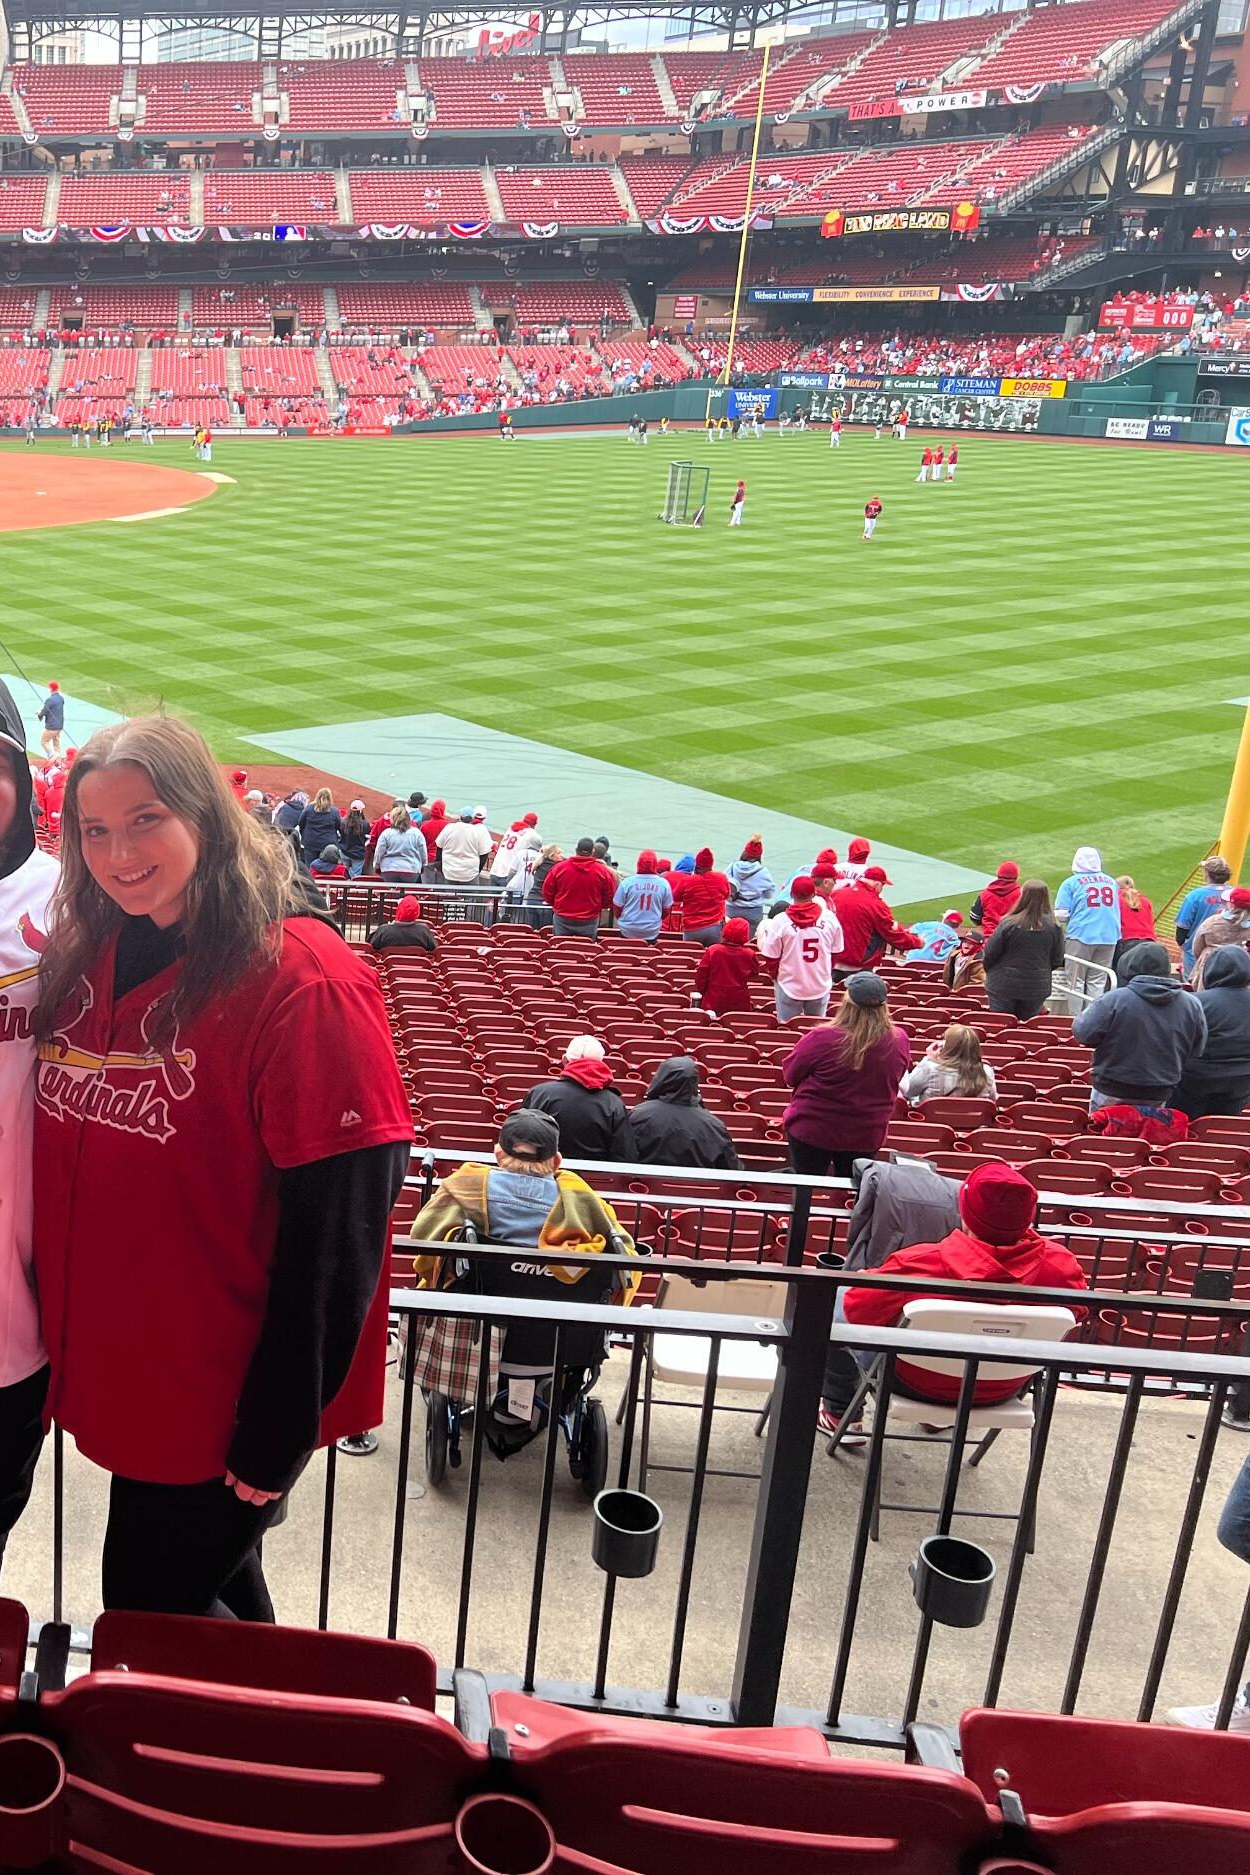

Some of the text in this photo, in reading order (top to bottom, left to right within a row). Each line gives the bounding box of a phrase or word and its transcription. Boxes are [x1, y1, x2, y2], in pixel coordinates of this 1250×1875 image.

[852, 95, 968, 118] THAT'S A POWER
[909, 212, 949, 229] LAND
[755, 290, 777, 300] Webster
[779, 289, 809, 301] University
[855, 290, 893, 298] CONVENIENCE
[899, 289, 934, 297] EXPERIENCE
[1207, 363, 1230, 374] Mercy
[894, 380, 938, 389] Central Bank
[955, 379, 997, 389] SITEMAN
[1013, 382, 1052, 392] DOBBS
[734, 391, 771, 402] Webster
[1154, 424, 1172, 434] WR
[639, 893, 653, 912] 11
[1086, 886, 1114, 908] 28
[791, 920, 825, 933] PLS
[802, 938, 819, 963] 5
